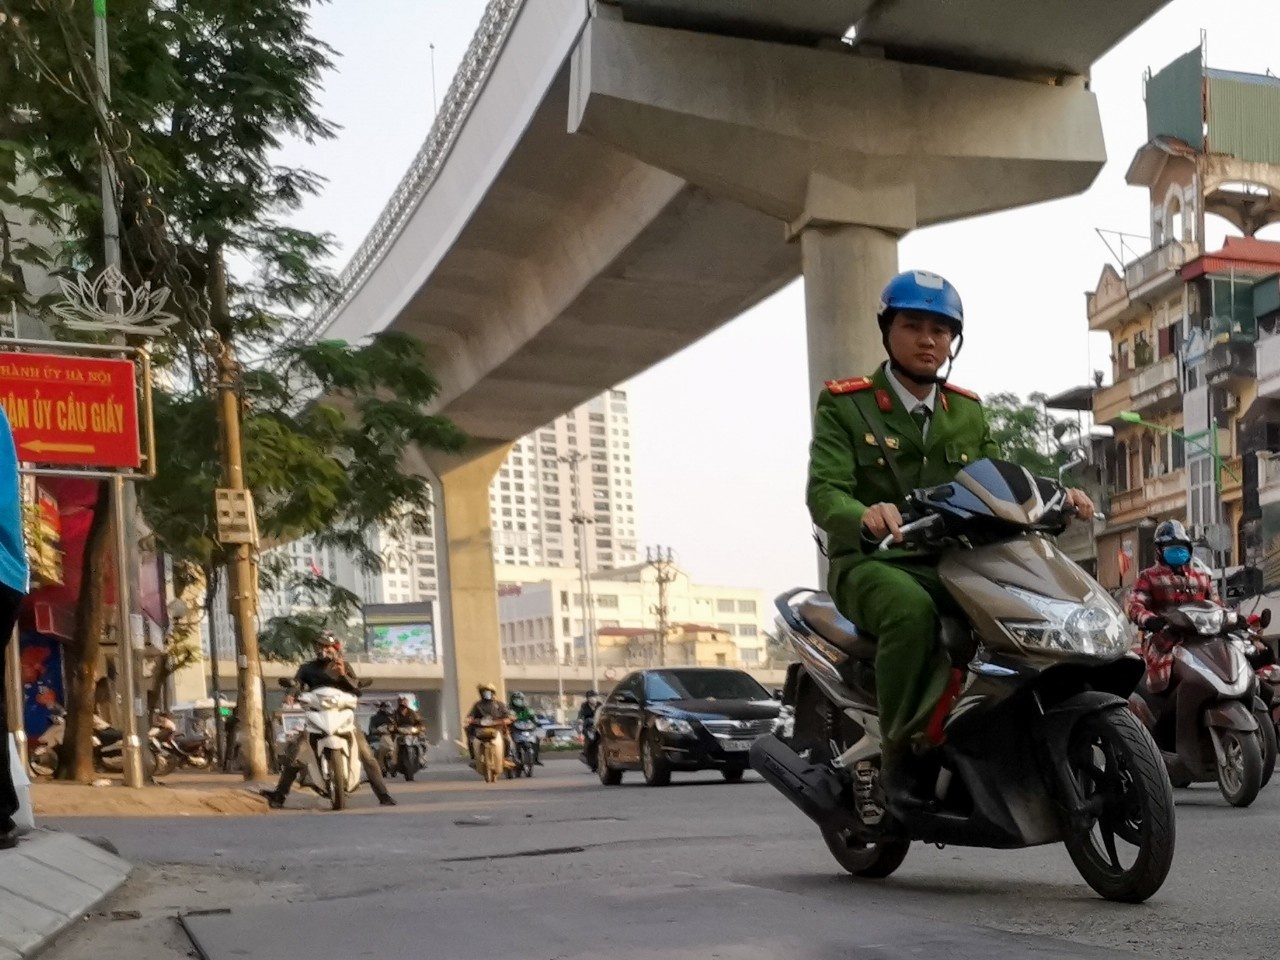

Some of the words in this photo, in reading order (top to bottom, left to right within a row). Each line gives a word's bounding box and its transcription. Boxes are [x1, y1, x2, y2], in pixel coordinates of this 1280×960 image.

[66, 368, 84, 381] HÀ
[33, 388, 51, 430] ỦY
[57, 391, 87, 432] CẦU
[91, 394, 123, 434] GIẤY
